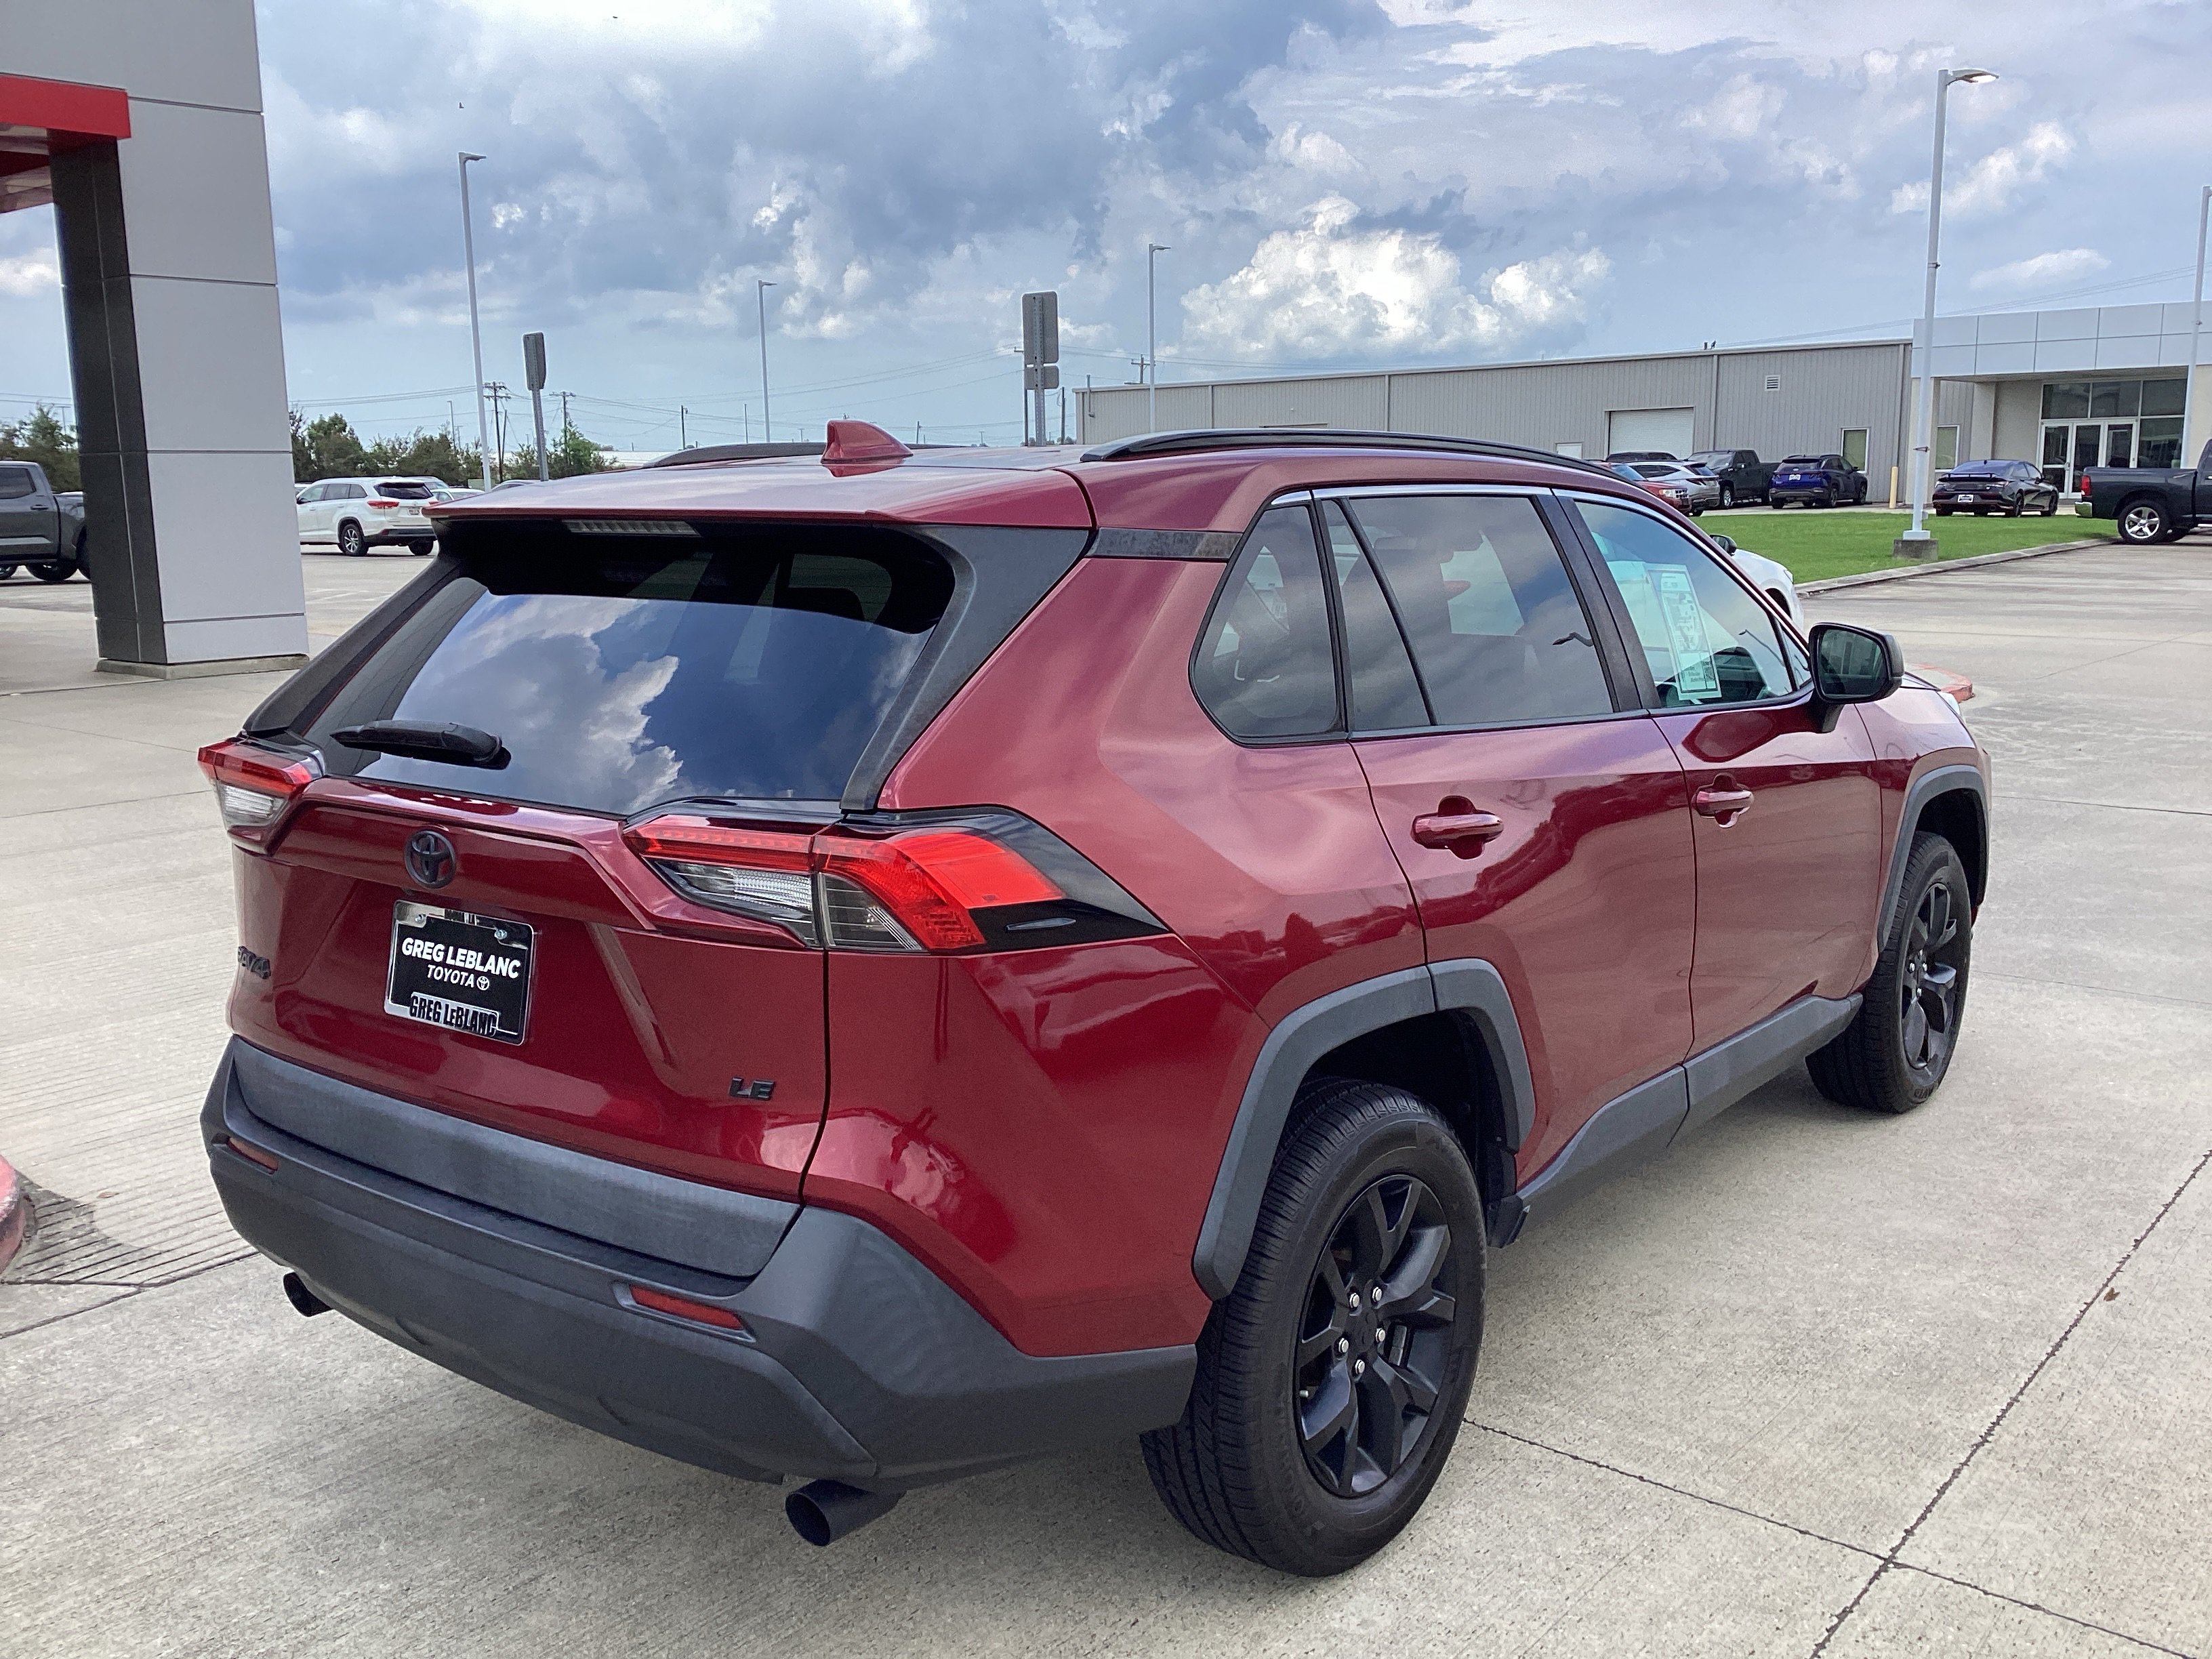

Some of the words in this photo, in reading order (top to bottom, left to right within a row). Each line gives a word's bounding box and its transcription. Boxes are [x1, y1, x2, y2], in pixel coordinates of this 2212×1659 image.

[402, 937, 445, 962] GREG
[445, 946, 521, 979] LEBLANC
[427, 964, 474, 988] TOYOTA
[409, 995, 442, 1023] GREG
[729, 1077, 775, 1101] LE
